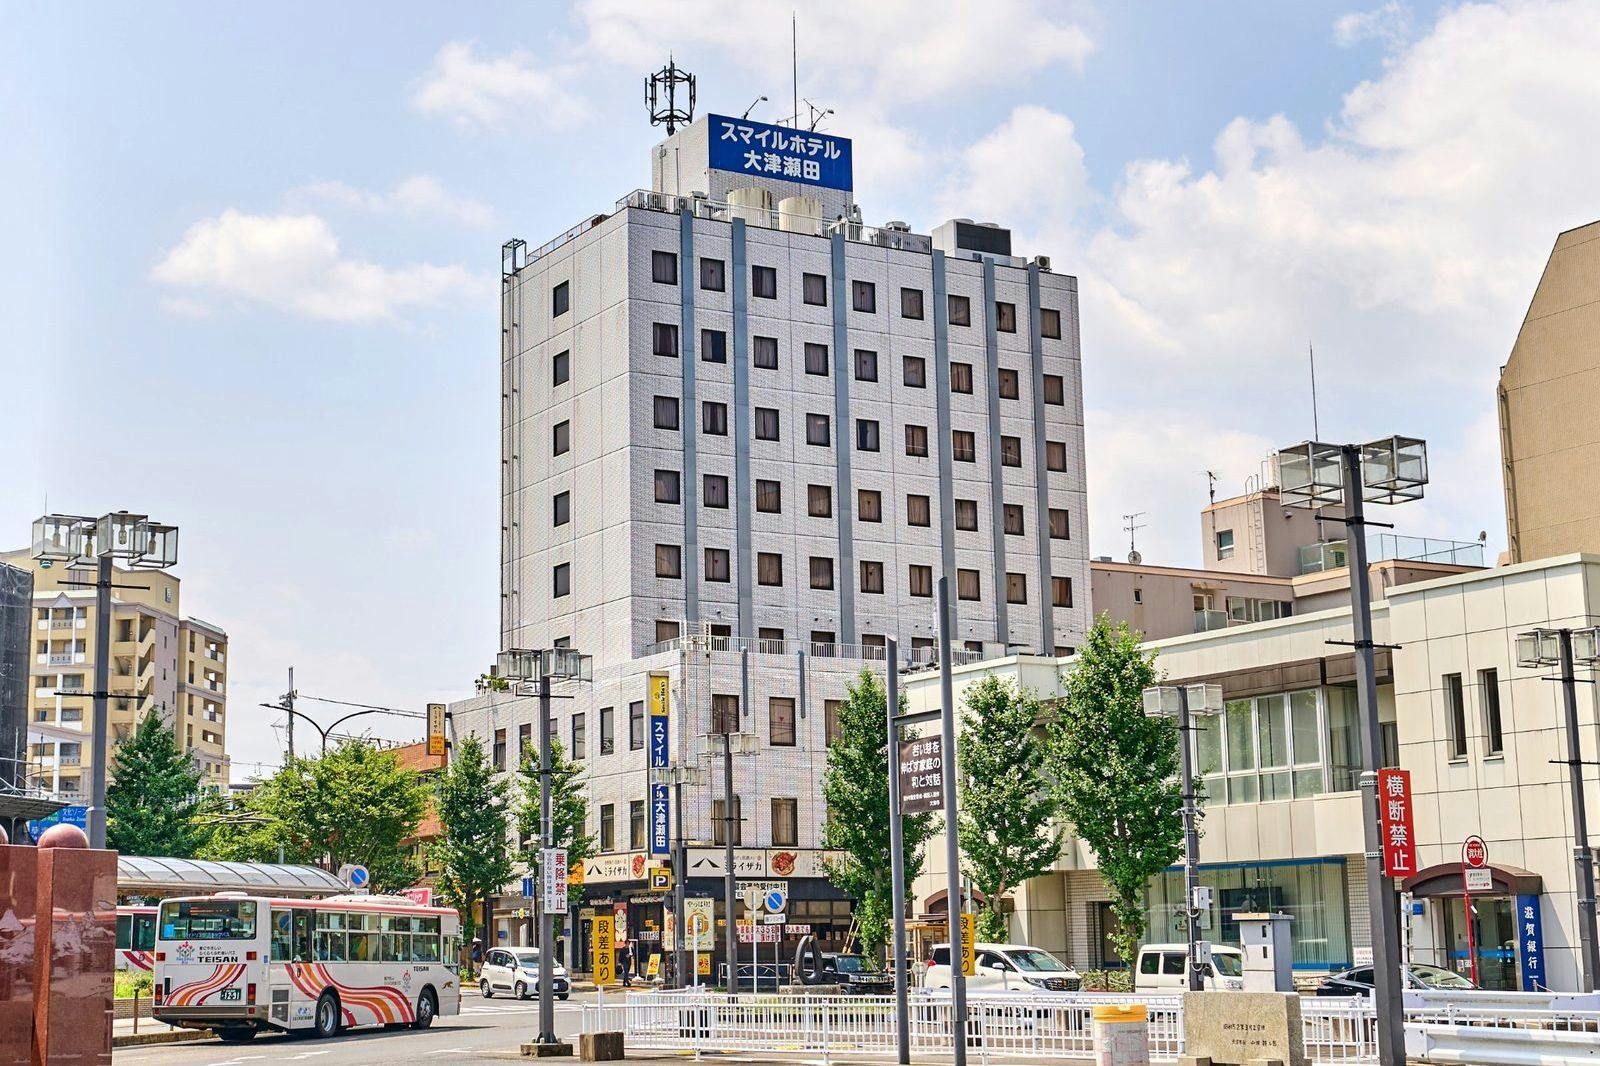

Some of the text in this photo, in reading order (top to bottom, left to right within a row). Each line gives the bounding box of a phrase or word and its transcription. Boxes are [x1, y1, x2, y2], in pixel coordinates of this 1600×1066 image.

[720, 122, 841, 160] スマイルホテル
[743, 149, 821, 181] 大津瀬田
[1386, 774, 1410, 871] 横断禁止
[555, 852, 566, 911] 乗降禁止
[655, 875, 667, 887] P
[197, 956, 239, 964] TEISAN
[598, 919, 610, 981] 段差あり
[1524, 905, 1538, 970] 滋賀銀行
